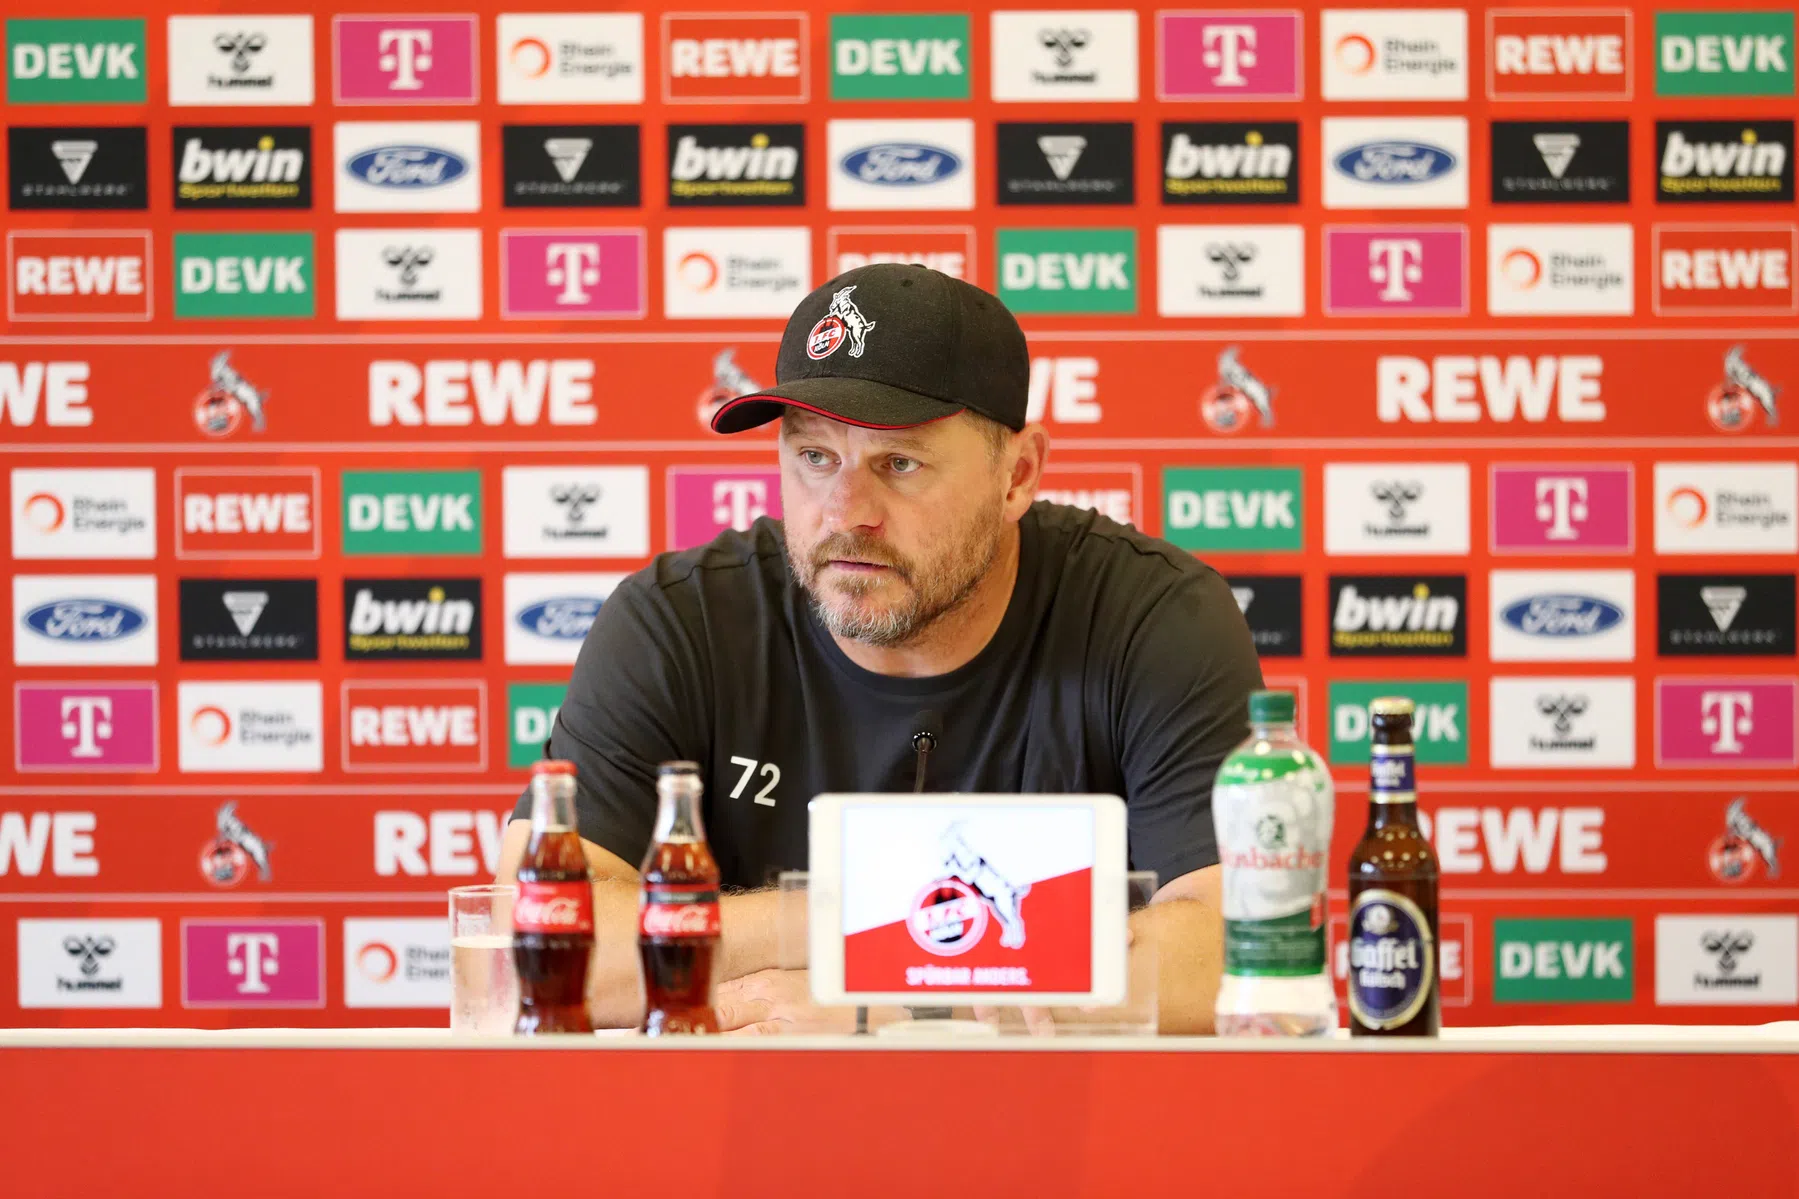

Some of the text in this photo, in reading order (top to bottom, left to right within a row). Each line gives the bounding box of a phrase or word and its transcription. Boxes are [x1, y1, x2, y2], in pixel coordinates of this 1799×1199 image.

[14, 44, 137, 78] DEVK
[671, 40, 800, 77] REWE
[836, 40, 962, 75] DEVK
[1495, 36, 1623, 74] REWE
[1662, 36, 1786, 72] DEVK
[207, 75, 274, 89] hummel
[1031, 70, 1097, 85] hummel
[180, 138, 303, 183] bwin
[366, 151, 448, 184] Ford
[672, 136, 797, 181] bwin
[859, 148, 941, 183] Ford
[1166, 134, 1291, 179] bwin
[1353, 144, 1435, 181] Ford
[1662, 132, 1785, 177] bwin
[180, 182, 298, 198] Sportwetten
[672, 180, 791, 196] Sportwetten
[1167, 178, 1285, 193] Sportwetten
[1662, 175, 1784, 192] Sportwetten
[17, 257, 143, 294] REWE
[182, 257, 305, 293] DEVK
[1003, 253, 1128, 290] DEVK
[1662, 250, 1788, 288] REWE
[374, 288, 442, 303] hummel
[1198, 285, 1264, 299] hummel
[369, 360, 597, 425] REWE
[1377, 356, 1605, 422] REWE
[184, 494, 311, 532] REWE
[349, 494, 473, 531] DEVK
[1169, 491, 1294, 528] DEVK
[543, 525, 608, 540] hummel
[1364, 522, 1430, 538] hummel
[46, 604, 124, 637] Ford
[350, 590, 473, 635] bwin
[1334, 586, 1457, 631] bwin
[1523, 598, 1602, 634] Ford
[350, 635, 470, 652] Sportwetten
[1334, 631, 1453, 648] Sportwetten
[351, 707, 477, 745] REWE
[1529, 735, 1596, 751] hummel
[730, 756, 781, 807] 72
[1418, 807, 1607, 874] EWE
[1500, 942, 1623, 978] DEVK
[56, 976, 123, 993] hummel
[1693, 973, 1761, 990] hummel
